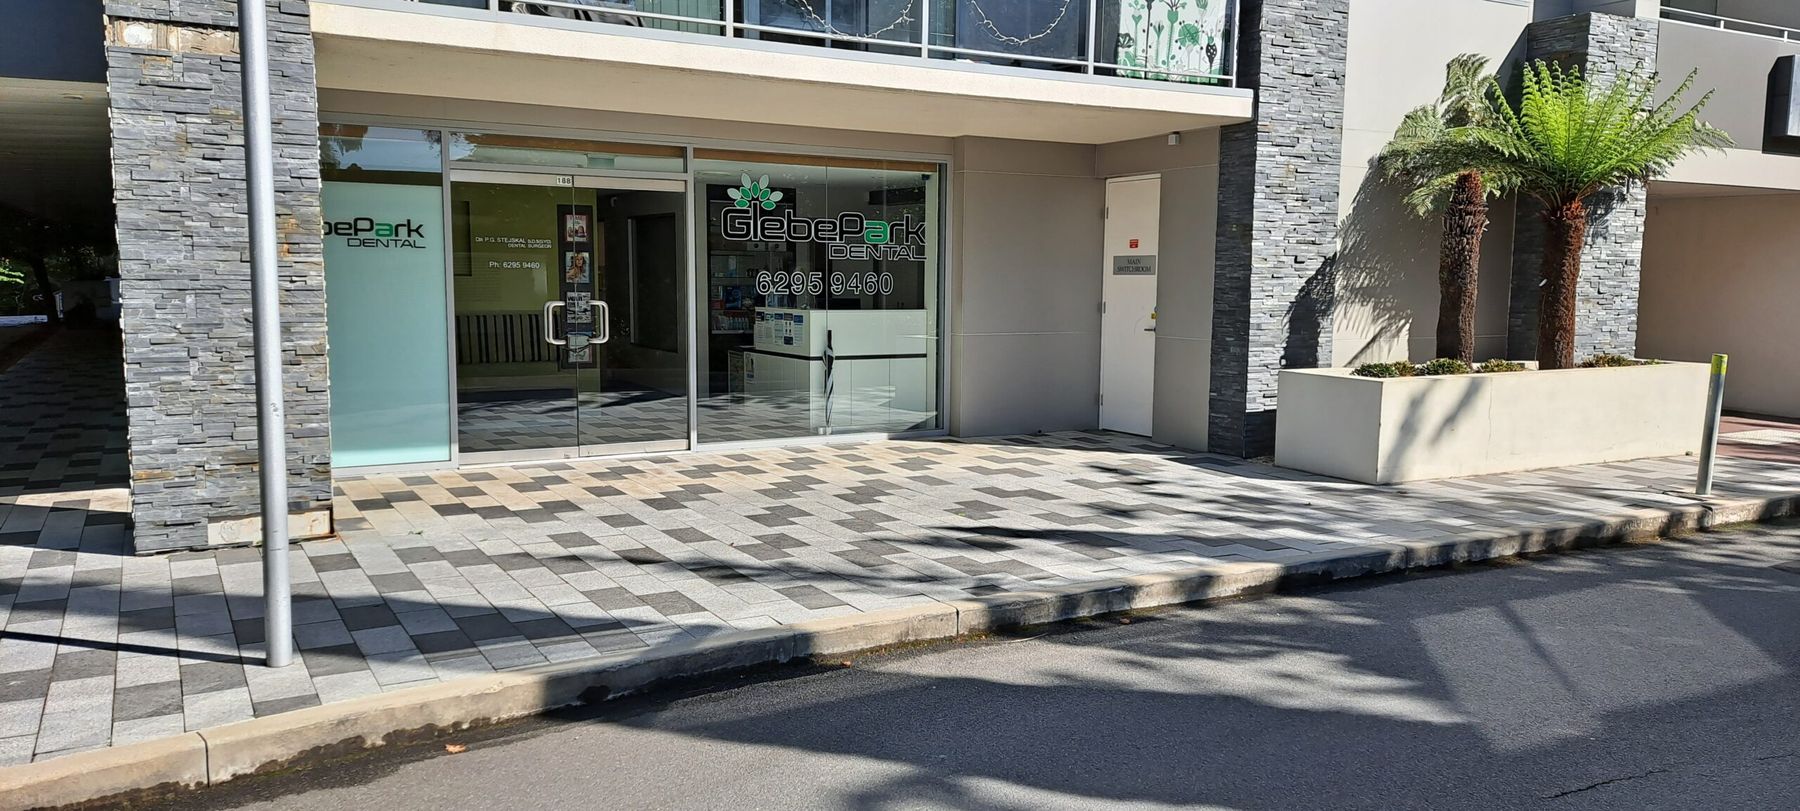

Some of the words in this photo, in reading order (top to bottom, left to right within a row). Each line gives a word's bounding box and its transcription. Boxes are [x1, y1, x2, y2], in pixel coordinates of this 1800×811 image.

[721, 200, 927, 245] GlebePark
[347, 238, 426, 248] DENTAL
[829, 244, 927, 261] DENTAL
[502, 261, 521, 269] 6295
[522, 261, 540, 269] 9460
[756, 271, 823, 295] 6295
[830, 272, 894, 296] 9460
